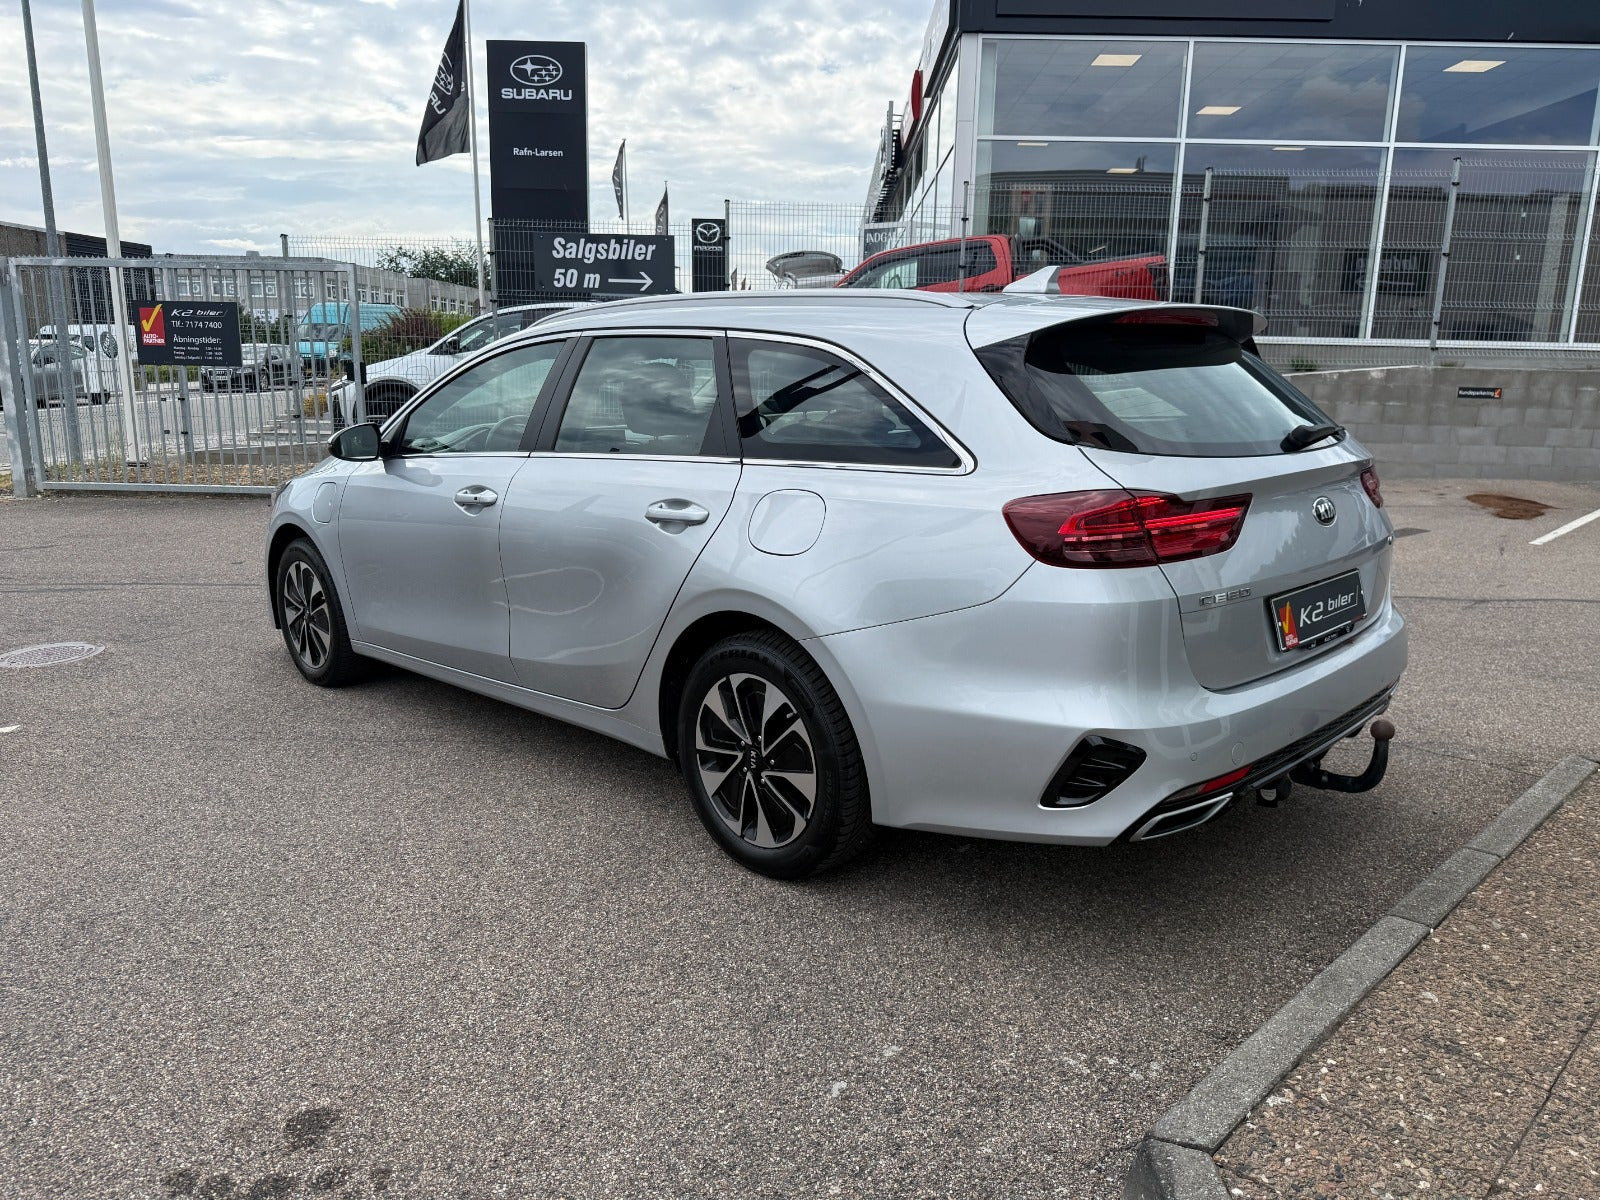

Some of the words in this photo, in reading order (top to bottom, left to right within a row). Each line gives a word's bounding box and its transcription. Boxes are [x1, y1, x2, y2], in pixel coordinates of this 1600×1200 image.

[501, 88, 573, 101] SUBARU
[513, 147, 564, 157] Rafn-Larsen
[552, 237, 656, 264] Salgsbiler
[553, 268, 579, 288] 50
[583, 273, 601, 289] m
[171, 308, 194, 317] K2
[185, 321, 203, 329] 7174
[173, 334, 222, 345] Åbningstider:
[1200, 587, 1251, 606] CEED
[1300, 601, 1324, 628] K2
[1327, 592, 1355, 611] biler
